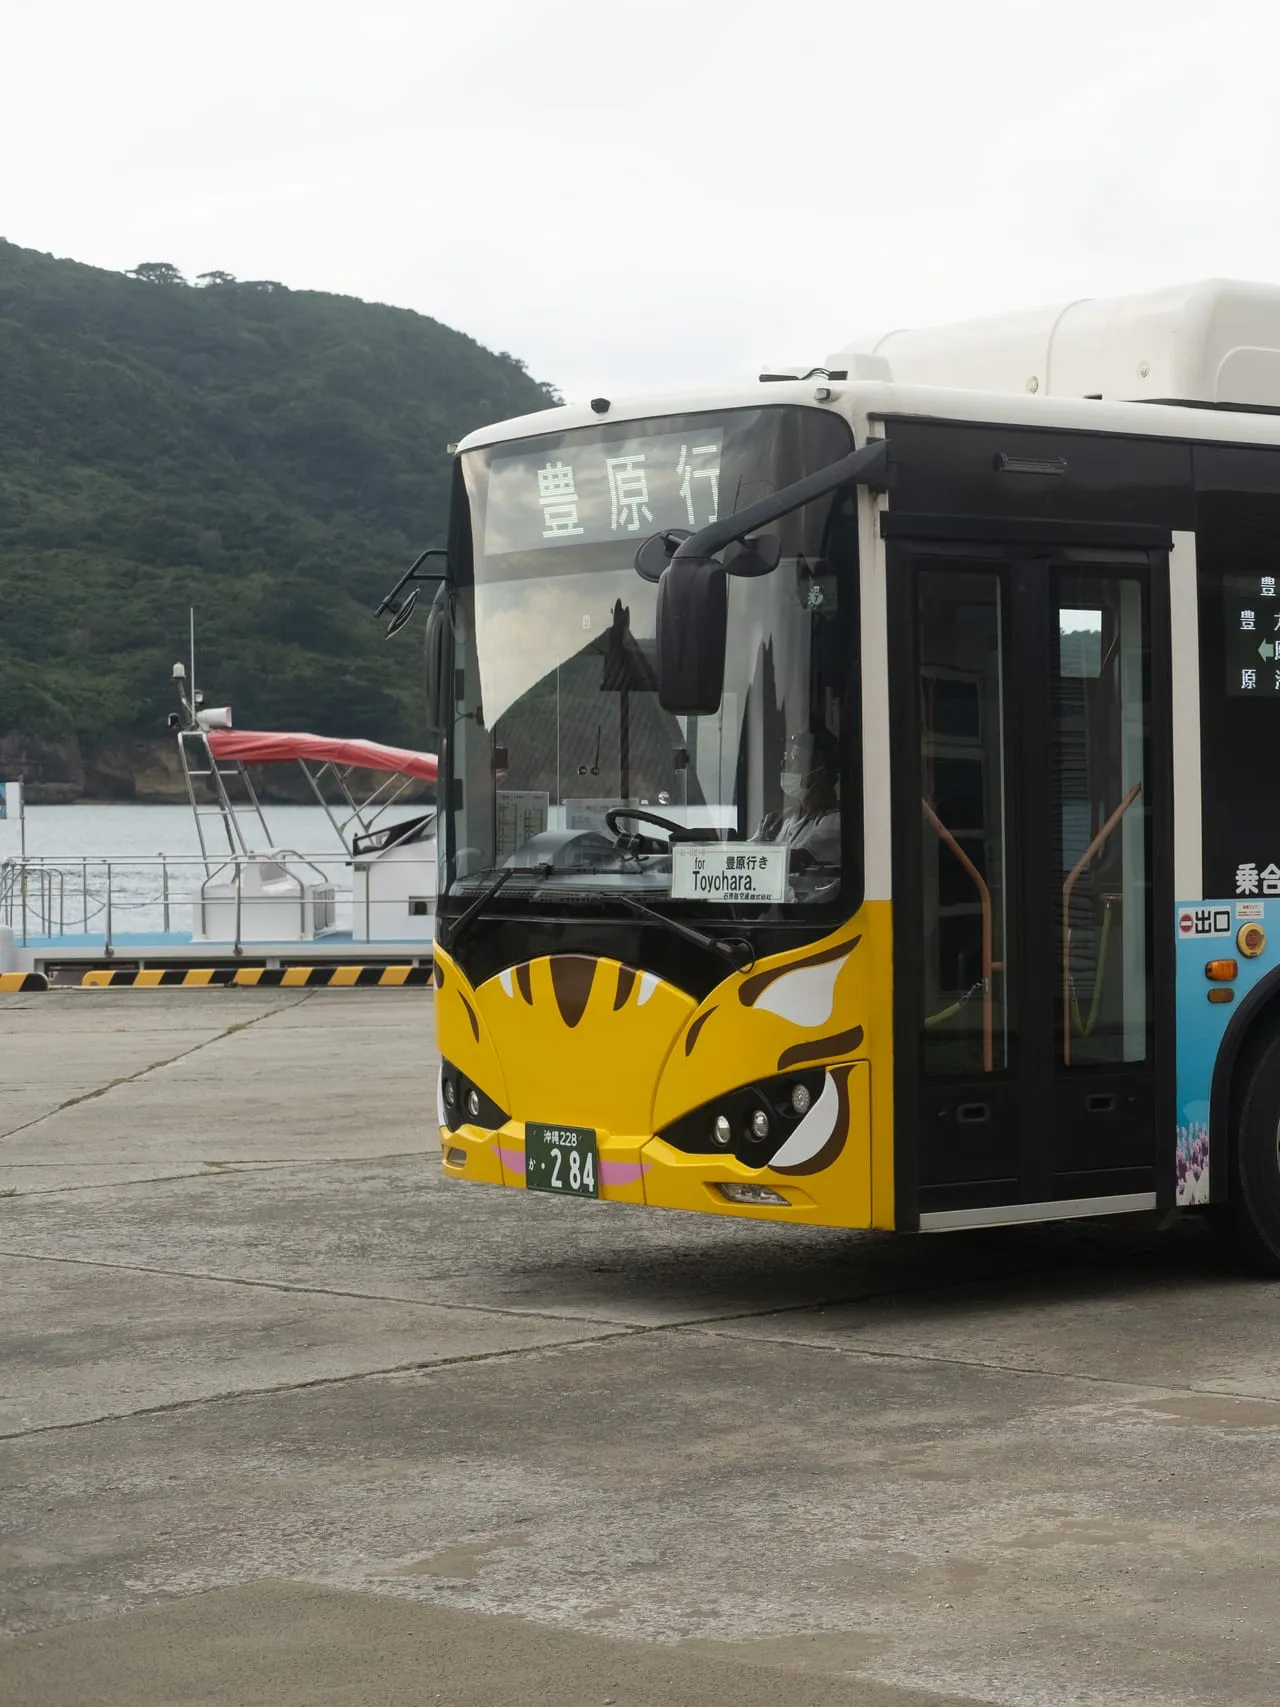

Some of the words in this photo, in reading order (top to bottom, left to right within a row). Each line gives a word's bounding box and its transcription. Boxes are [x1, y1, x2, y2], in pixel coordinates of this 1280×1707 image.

[537, 444, 721, 538] 豊原行
[694, 857, 706, 870] for
[725, 856, 768, 870] 豊原行き
[693, 871, 756, 892] Toyohara.
[1194, 910, 1231, 935] 出口
[544, 1130, 577, 1146] 沖縄228
